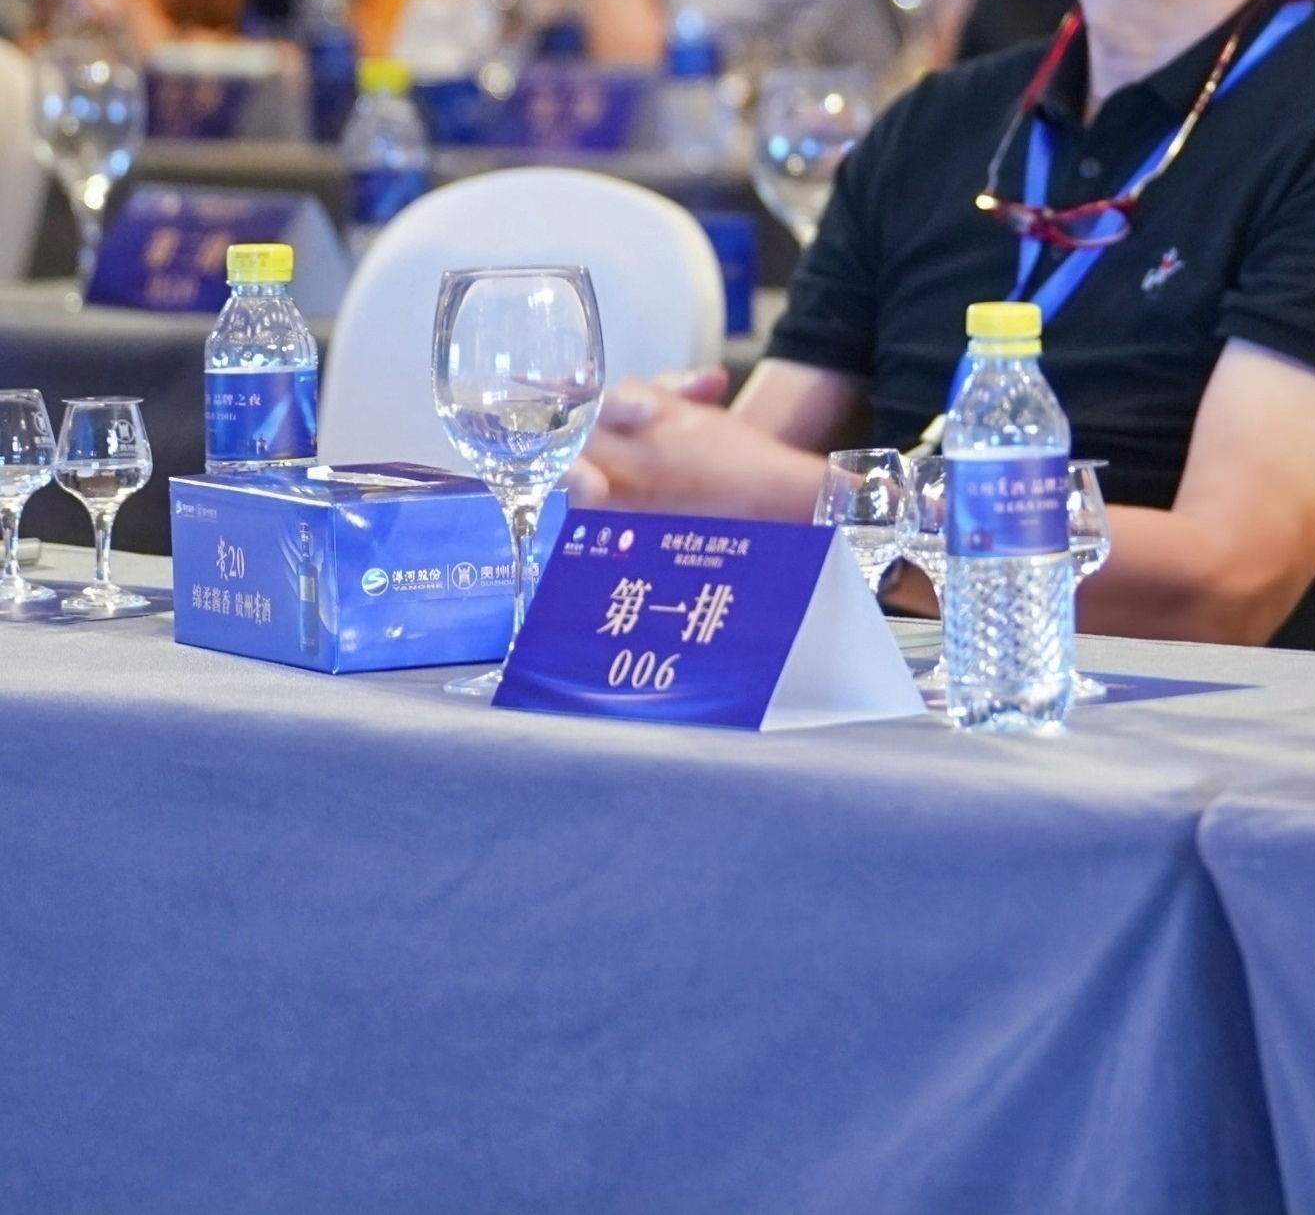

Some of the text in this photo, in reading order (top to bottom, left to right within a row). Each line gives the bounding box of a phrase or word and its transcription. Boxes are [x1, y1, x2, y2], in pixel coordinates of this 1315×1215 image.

[391, 568, 442, 583] 洋河股份
[480, 562, 540, 580] 贵州酒
[596, 576, 735, 645] 第一排
[607, 648, 682, 691] 006
